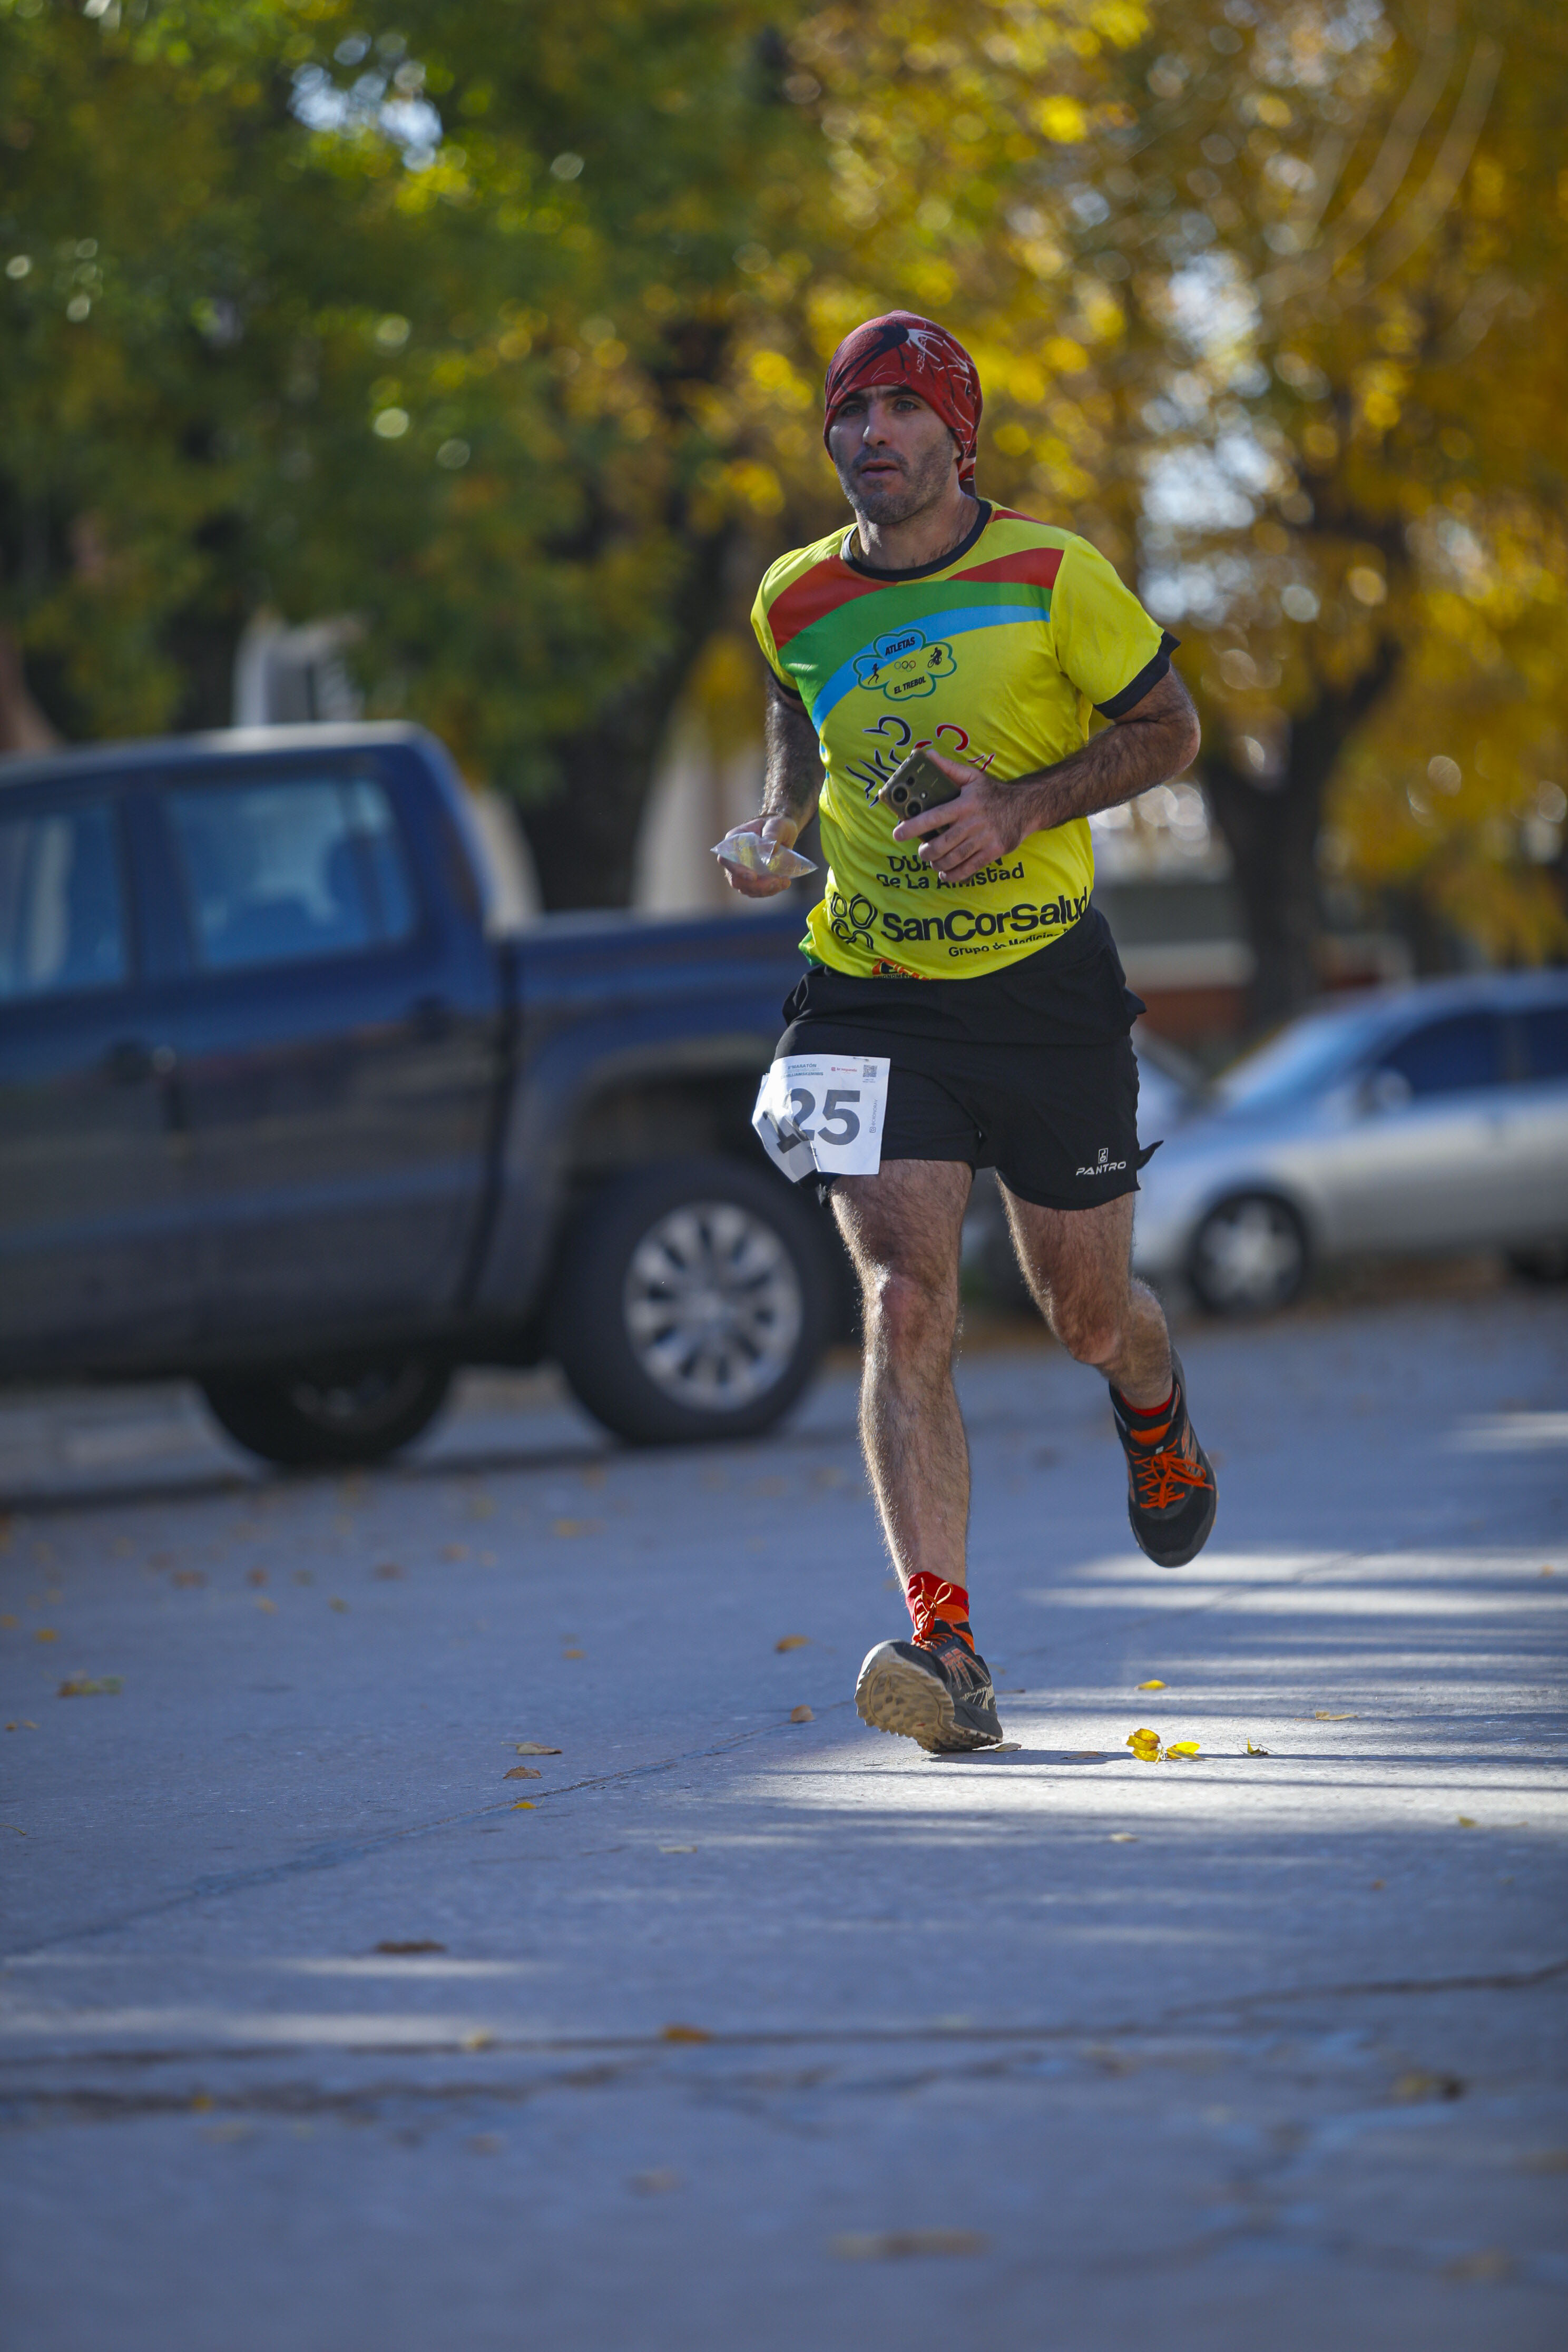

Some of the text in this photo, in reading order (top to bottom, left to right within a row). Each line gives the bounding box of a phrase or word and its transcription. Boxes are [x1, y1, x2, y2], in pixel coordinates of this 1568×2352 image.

[885, 636, 915, 656] ATLETAS
[894, 676, 926, 694] EL TREBOL
[905, 874, 929, 889] La
[881, 886, 1087, 942] SanCorSalud
[949, 945, 989, 957] Grupo
[1075, 1161, 1126, 1176] PANTRO
